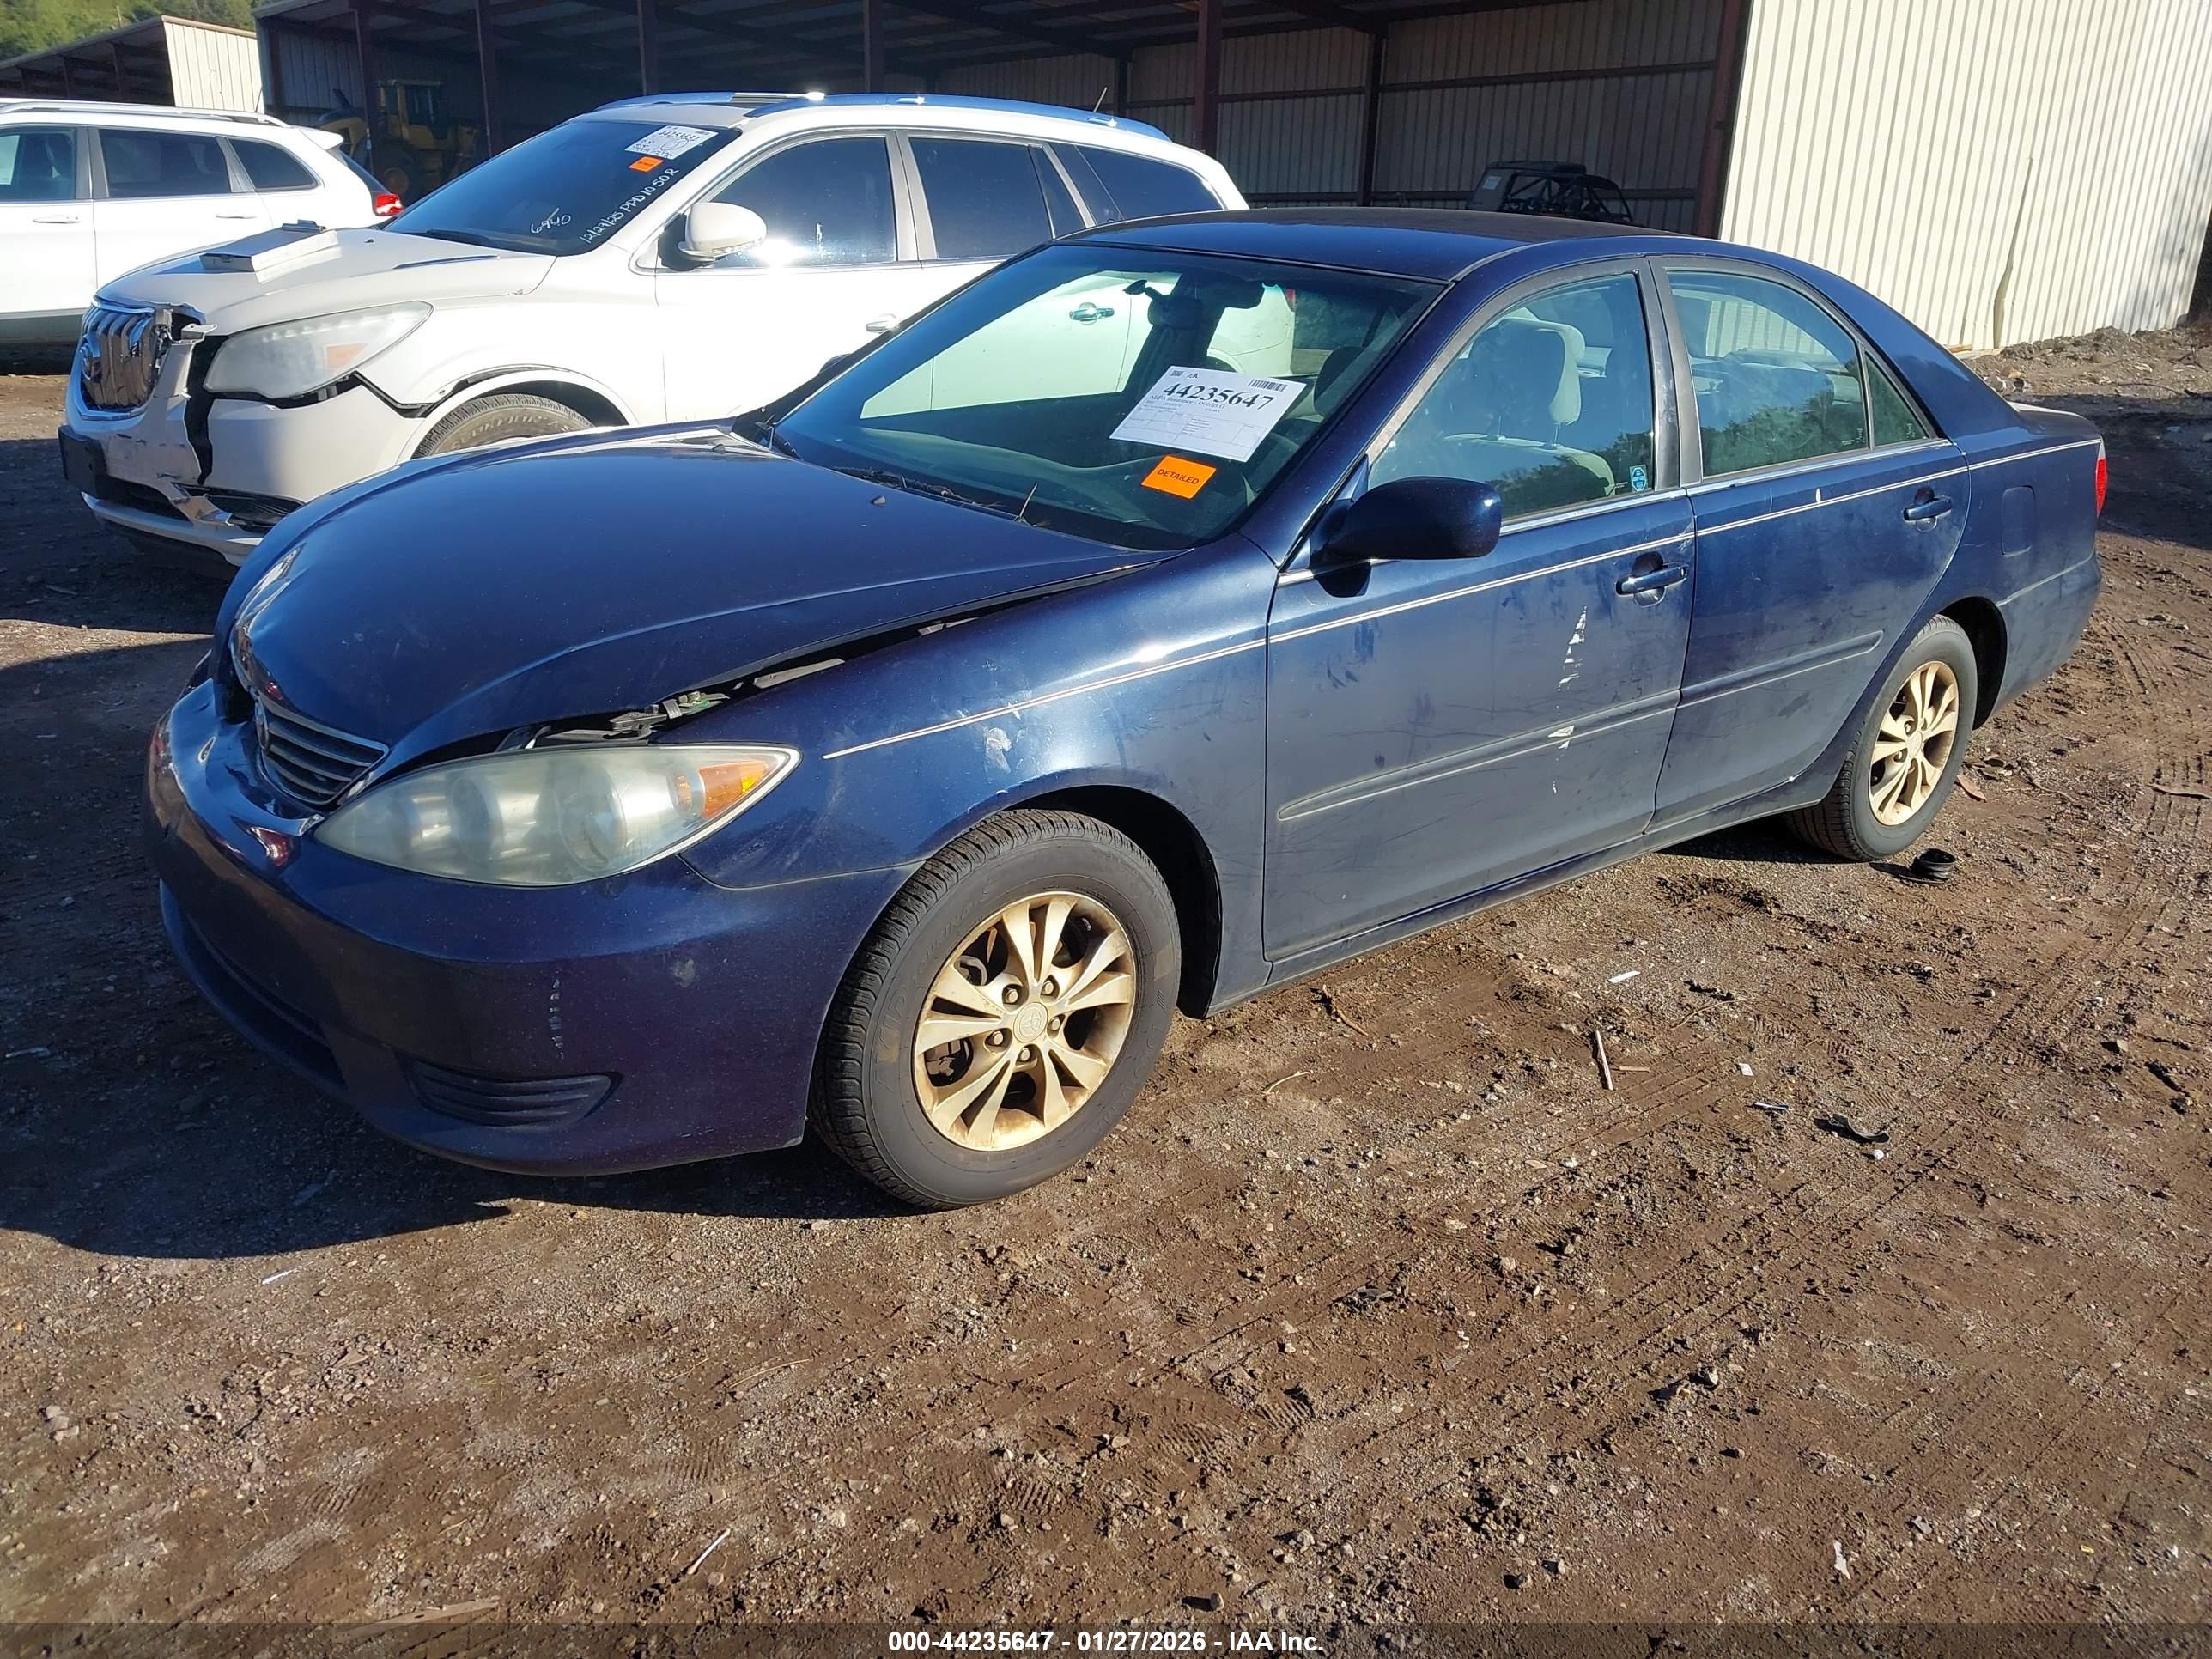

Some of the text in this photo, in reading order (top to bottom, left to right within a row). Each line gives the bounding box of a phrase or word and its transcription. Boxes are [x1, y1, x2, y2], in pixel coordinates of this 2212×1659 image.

[619, 195, 646, 213] PPD
[665, 168, 679, 178] R
[1164, 383, 1276, 410] 44235647
[1158, 468, 1200, 485] DETAILED
